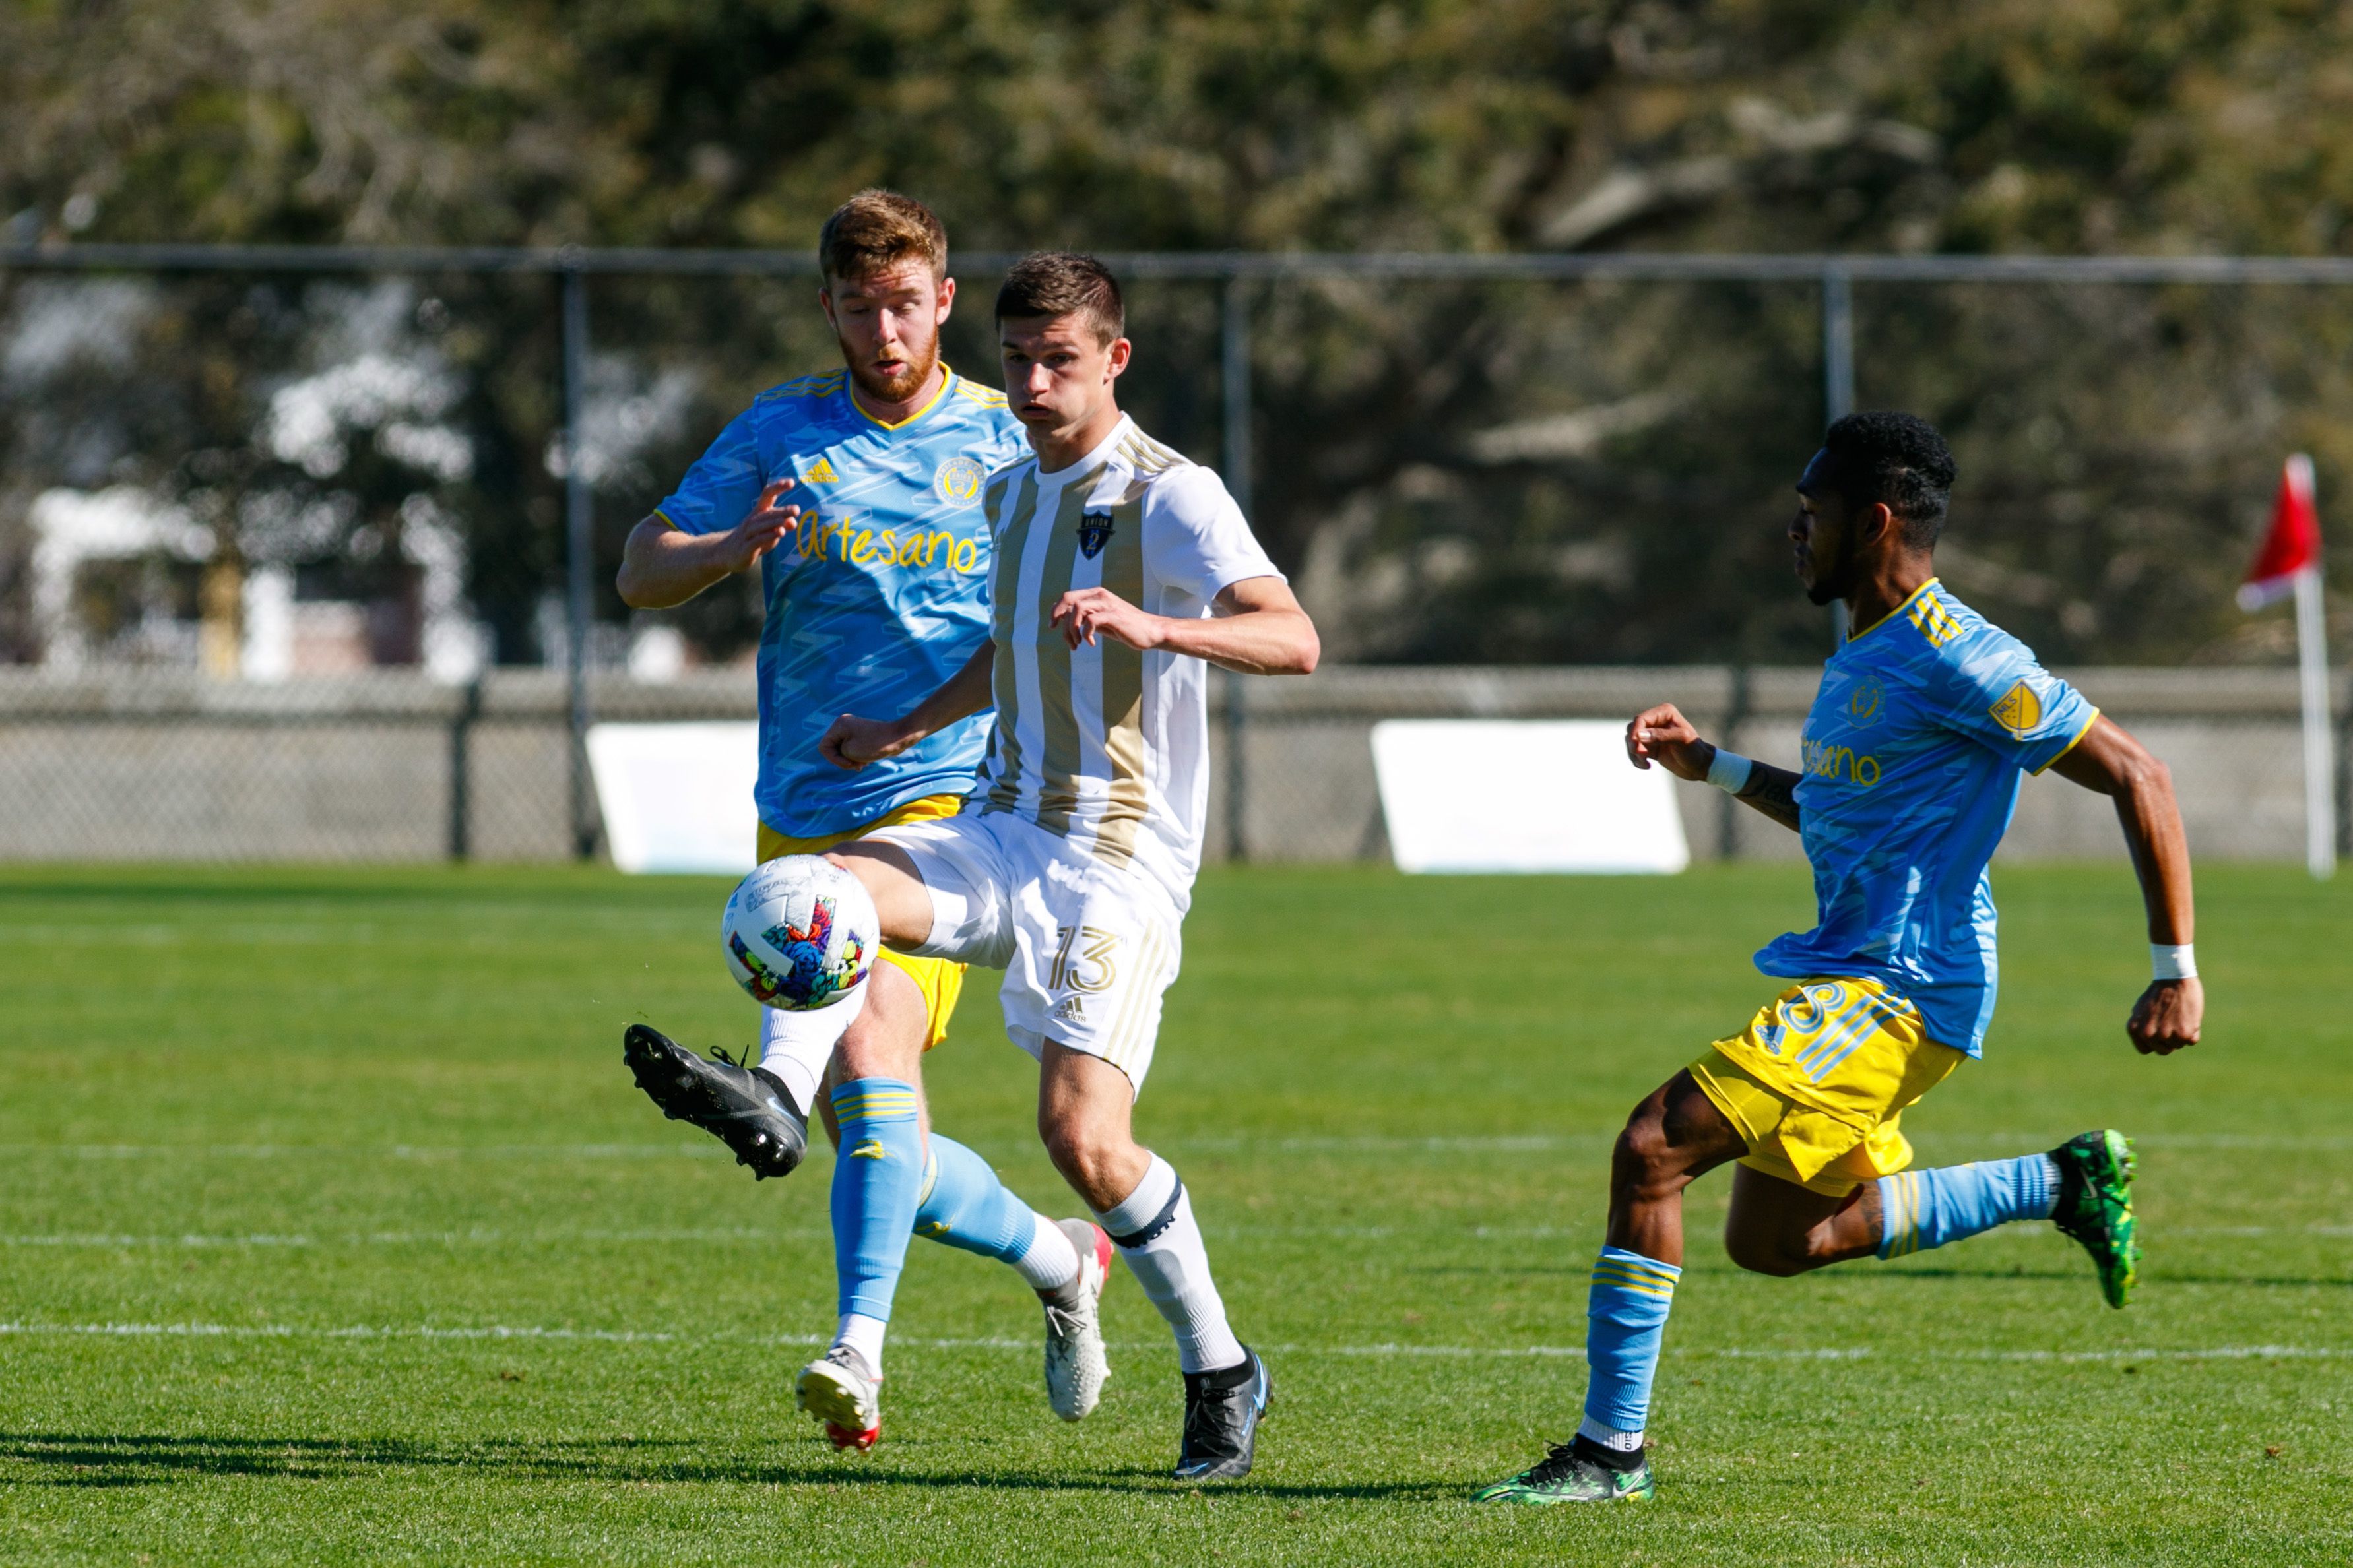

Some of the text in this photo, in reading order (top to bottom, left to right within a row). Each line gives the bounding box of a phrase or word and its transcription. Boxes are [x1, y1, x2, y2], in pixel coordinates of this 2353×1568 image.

[800, 474, 839, 484] adidas
[1086, 532, 1100, 551] 2
[1048, 925, 1118, 995] 13
